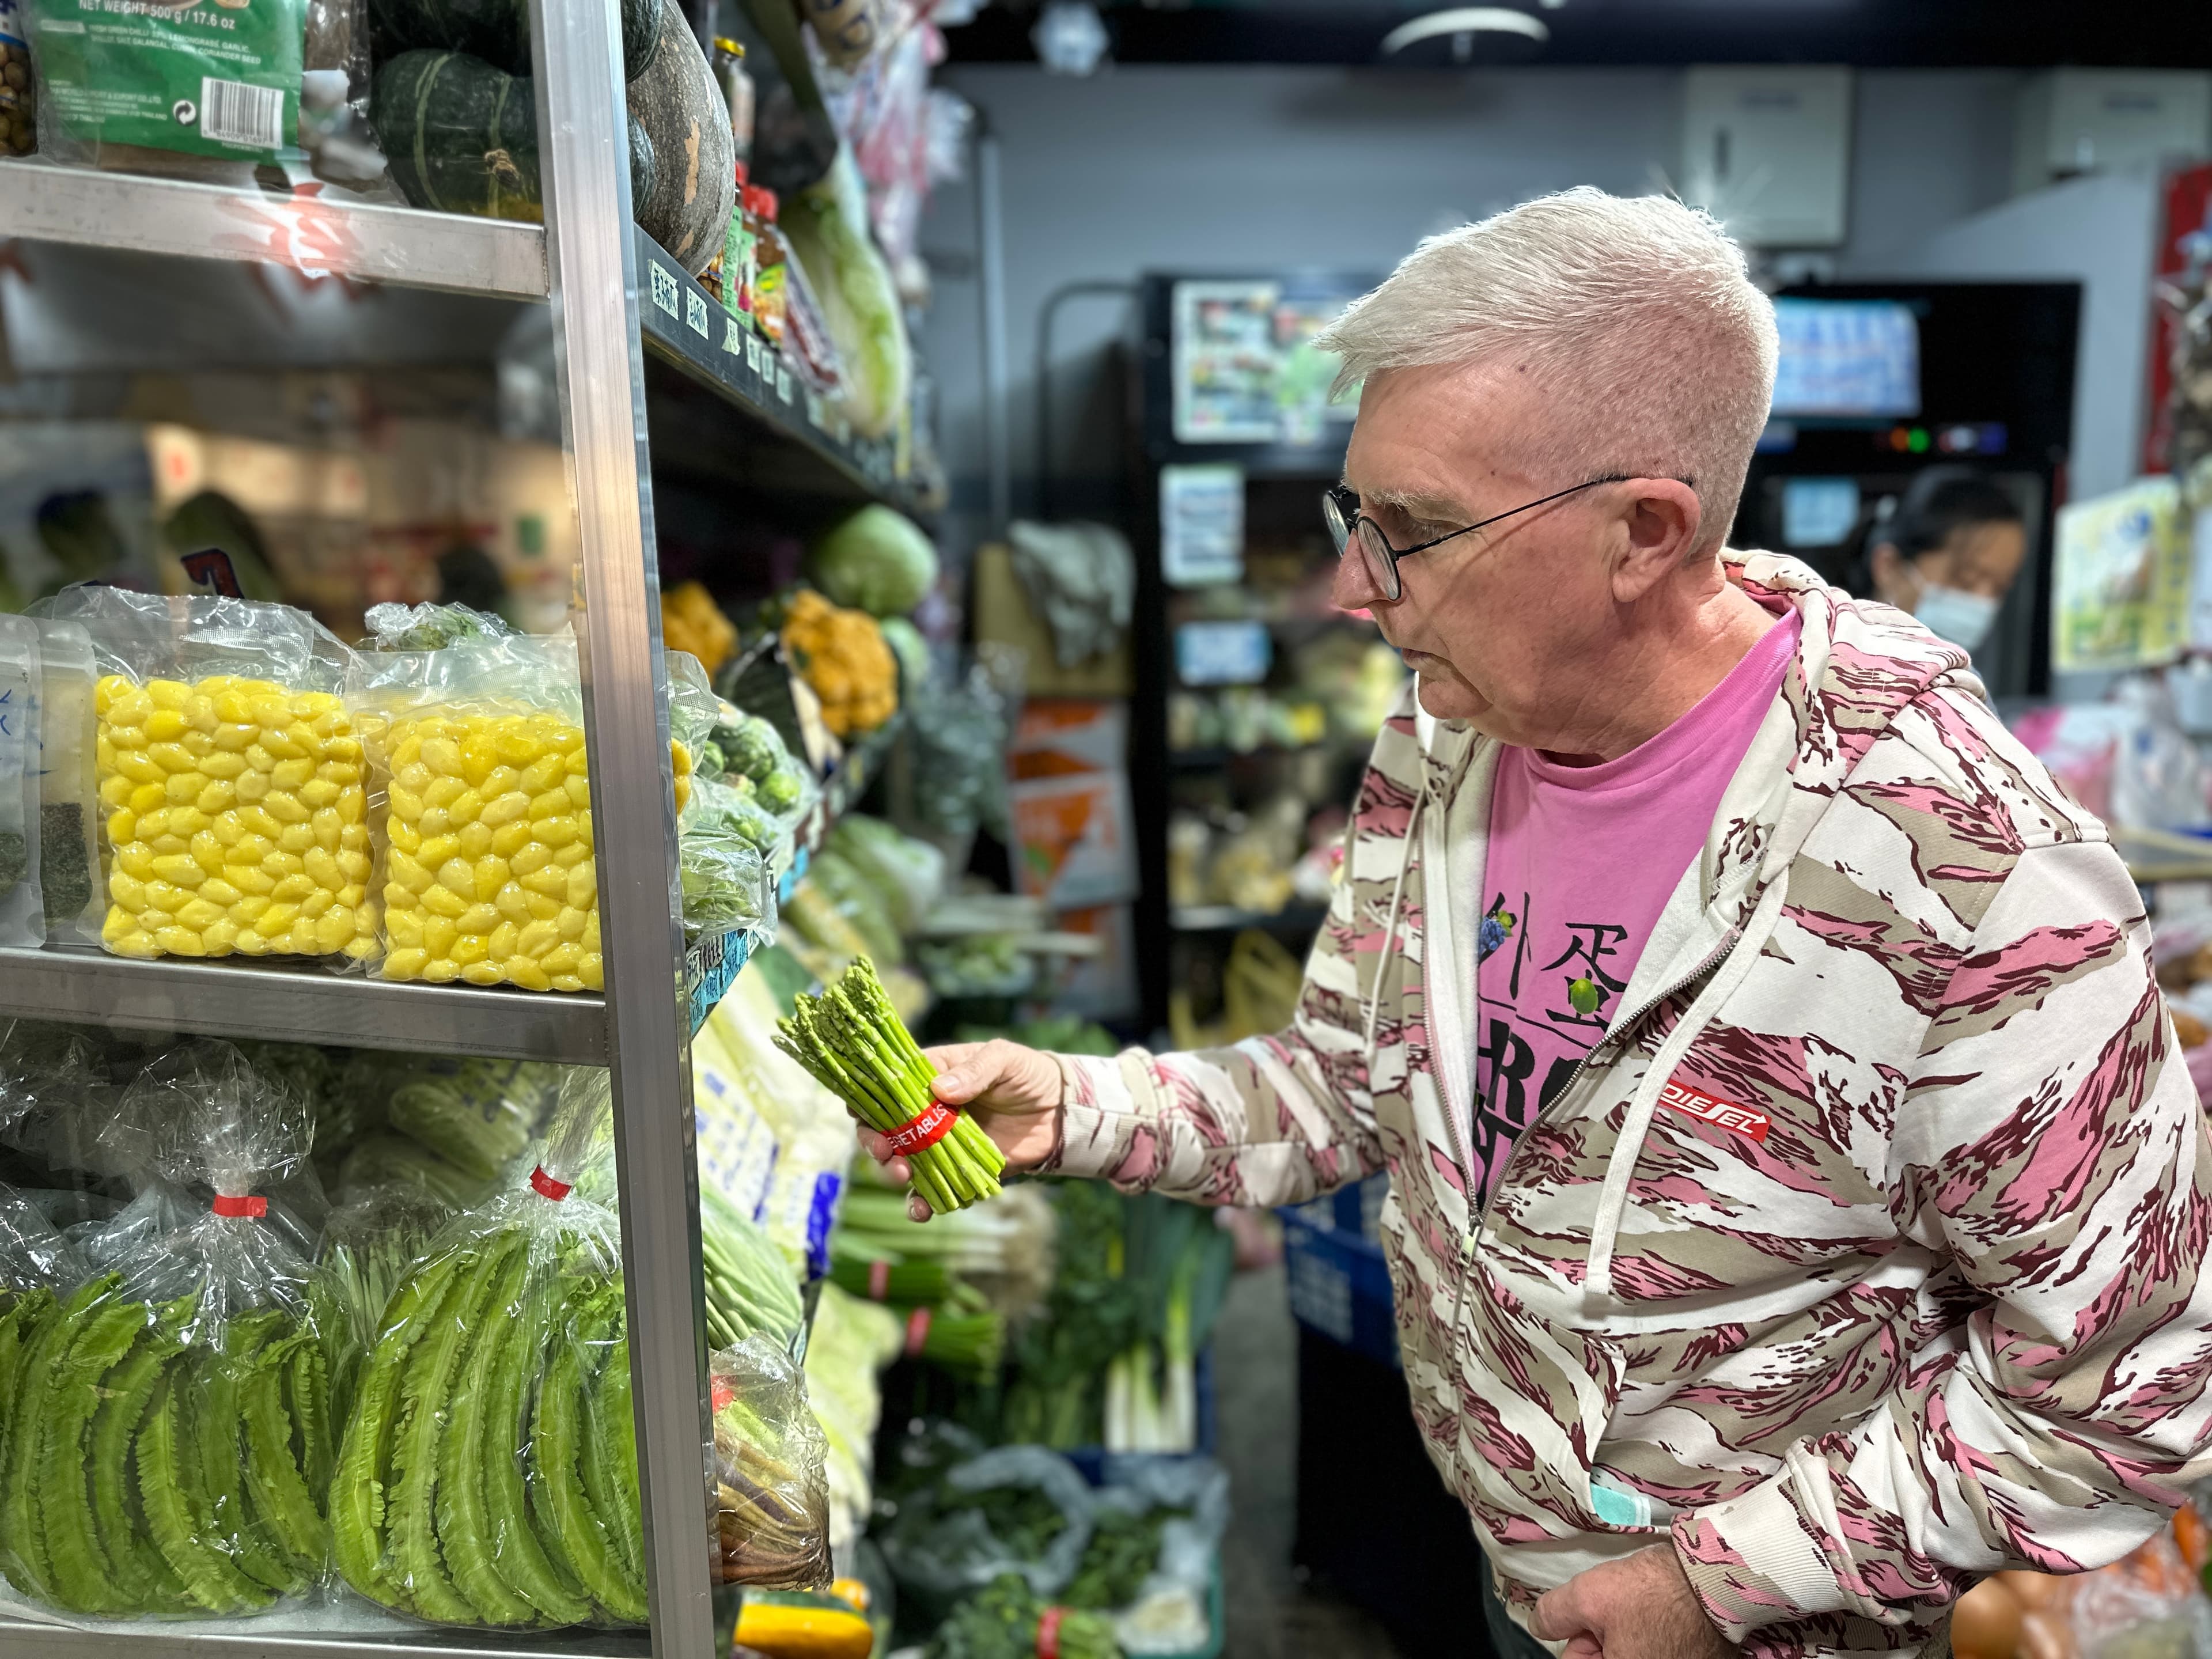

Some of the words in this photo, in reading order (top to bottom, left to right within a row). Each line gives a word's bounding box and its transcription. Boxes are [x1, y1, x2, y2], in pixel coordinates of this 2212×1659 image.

[79, 0, 100, 10] NET
[104, 1, 147, 15] WEIGHT
[150, 5, 171, 19] 500
[175, 11, 182, 24] g
[193, 11, 218, 26] 17.6
[221, 18, 236, 29] oz
[1661, 1083, 1767, 1134] DIESEL
